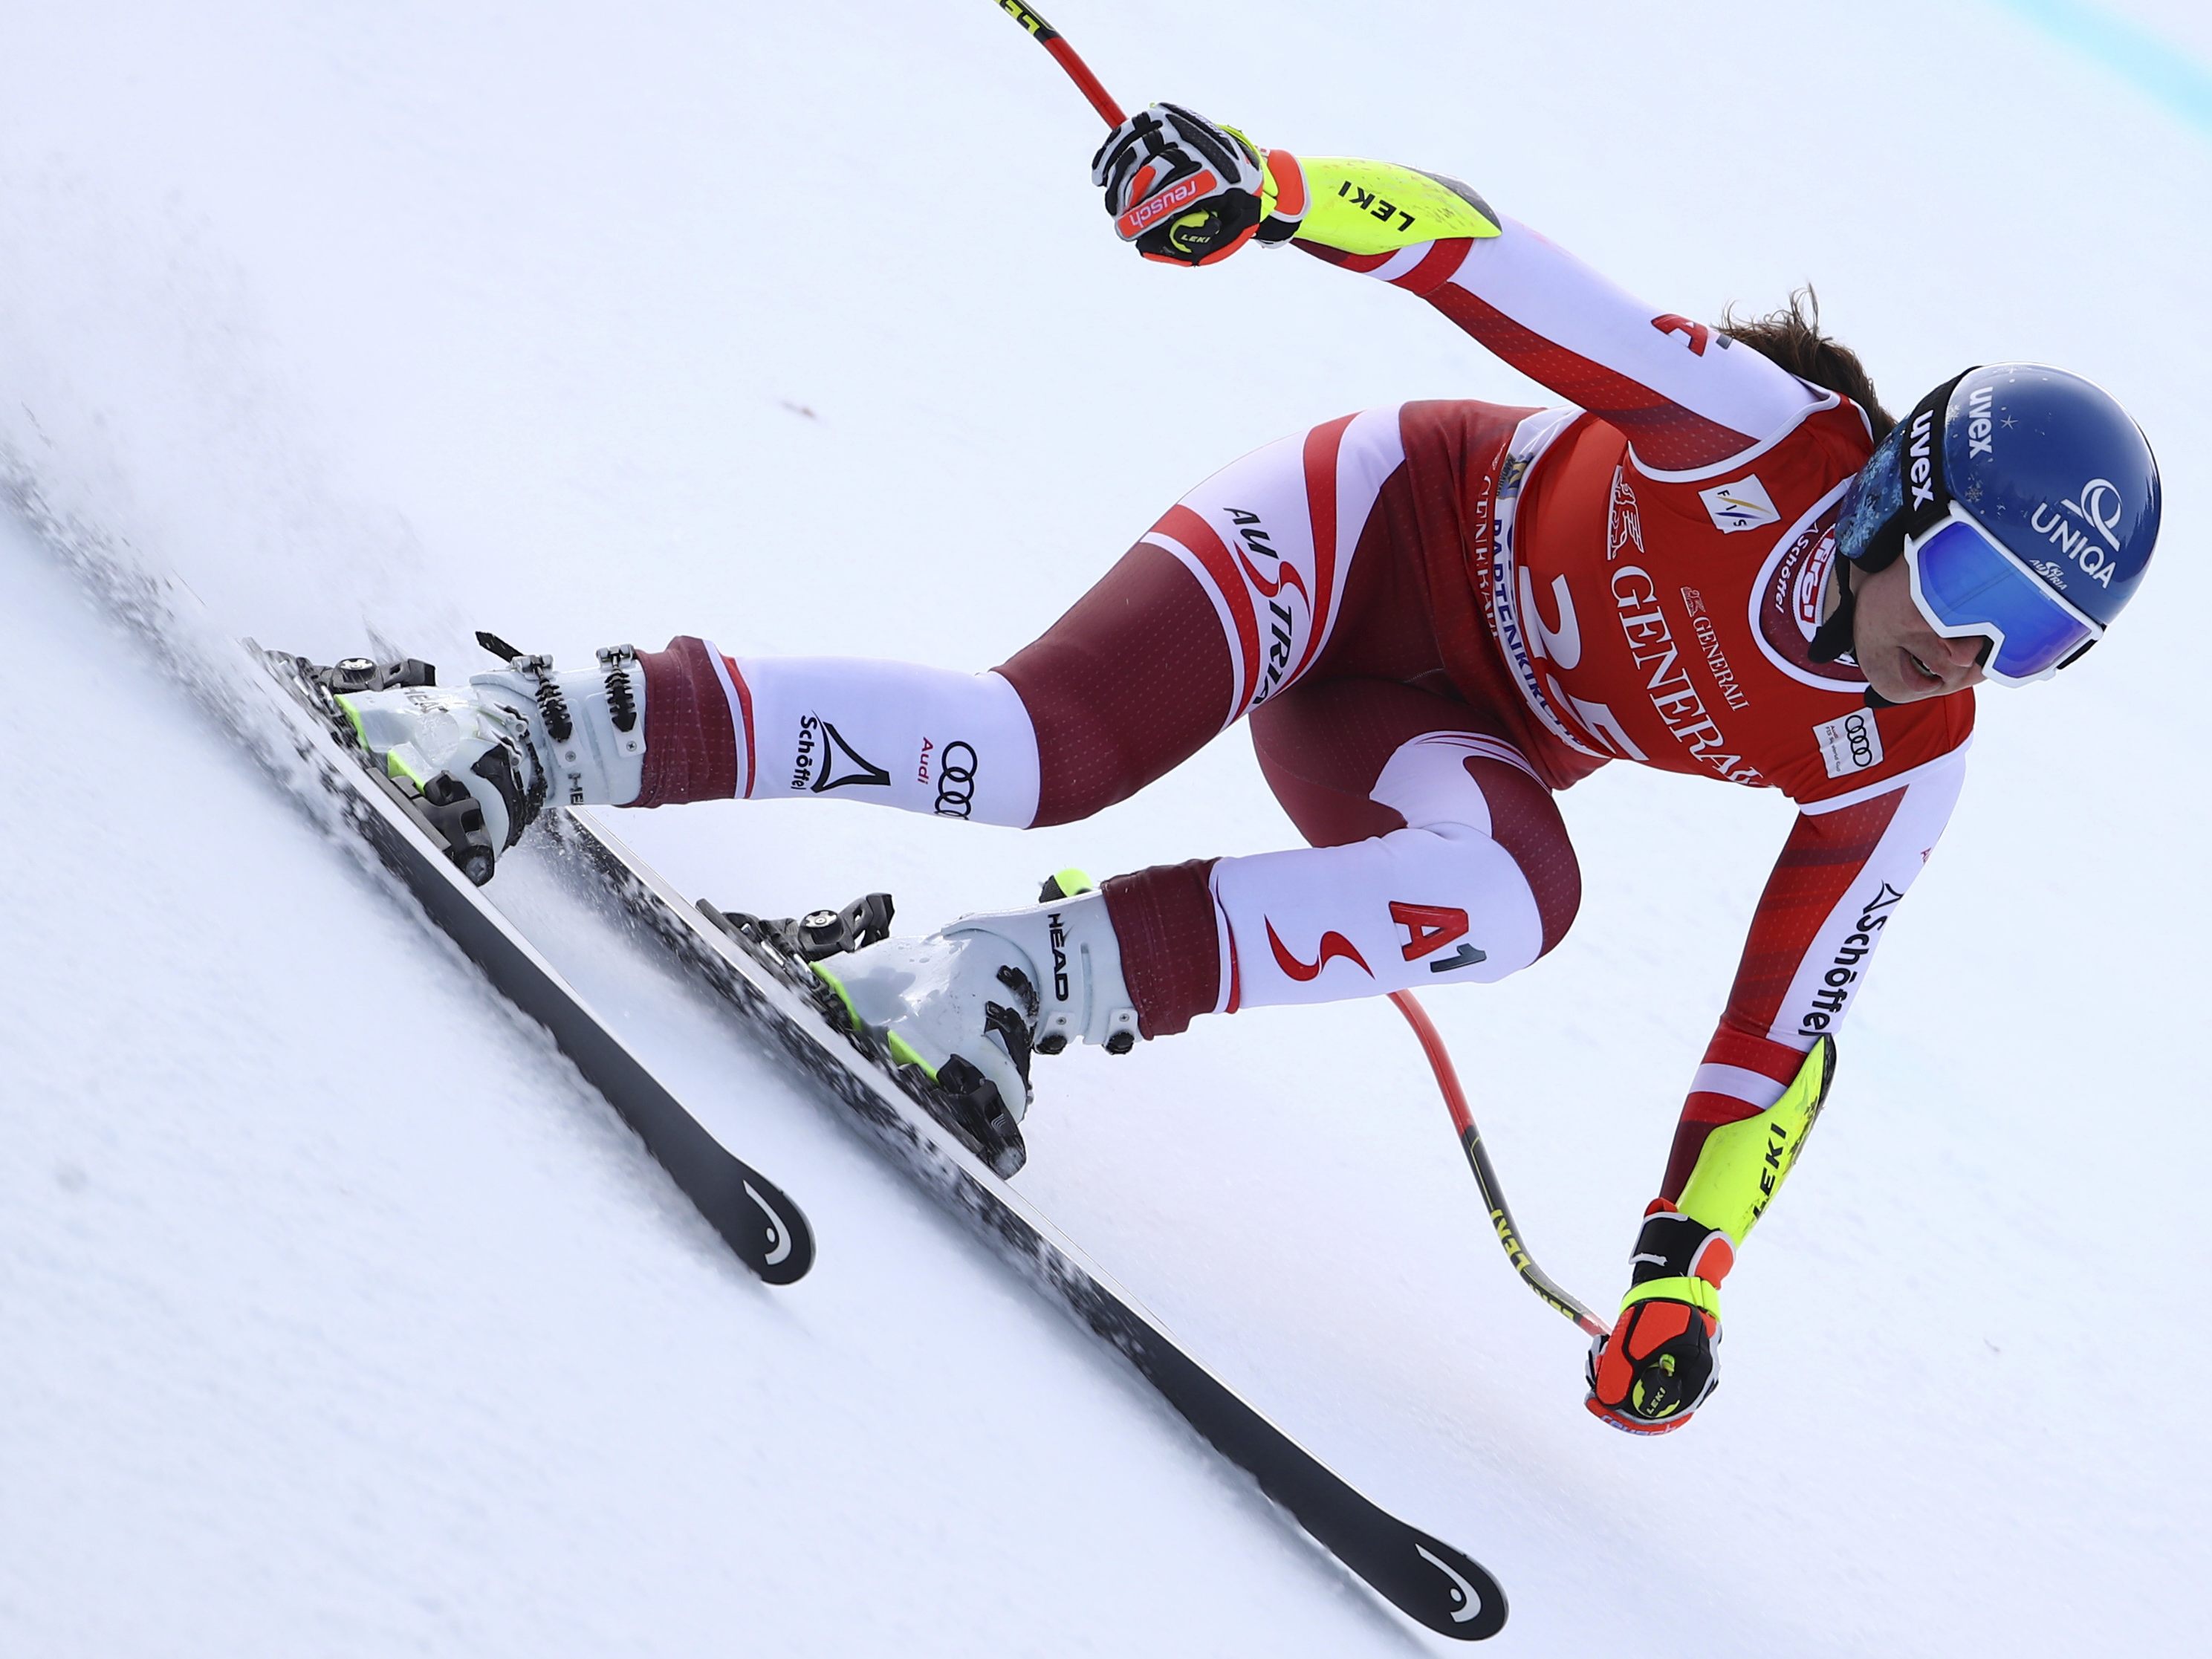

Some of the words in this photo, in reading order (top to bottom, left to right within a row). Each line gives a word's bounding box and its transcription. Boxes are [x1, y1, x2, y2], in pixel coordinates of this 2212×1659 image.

[1129, 180, 1196, 228] reusch
[1181, 233, 1211, 244] LEKI
[1338, 181, 1415, 232] LEKI
[1968, 386, 1994, 460] uvex
[1910, 409, 1934, 512] uvex
[1717, 490, 1748, 527] FIS
[2031, 501, 2116, 589] UNIQA
[1223, 507, 1311, 704] AUSTRIA
[1775, 535, 1810, 614] Schöffel
[2028, 559, 2068, 590] AUSTRIA
[1693, 616, 1750, 712] GENERALI
[791, 715, 818, 790] Schöffel
[917, 737, 935, 785] Audi
[1047, 913, 1069, 1001] HEAD
[1388, 900, 1487, 973] A1
[1798, 914, 1888, 1036] Schöffel
[1753, 1123, 1787, 1220] LEKI
[1491, 1209, 1531, 1272] LEKI
[1647, 1387, 1667, 1415] LEKI
